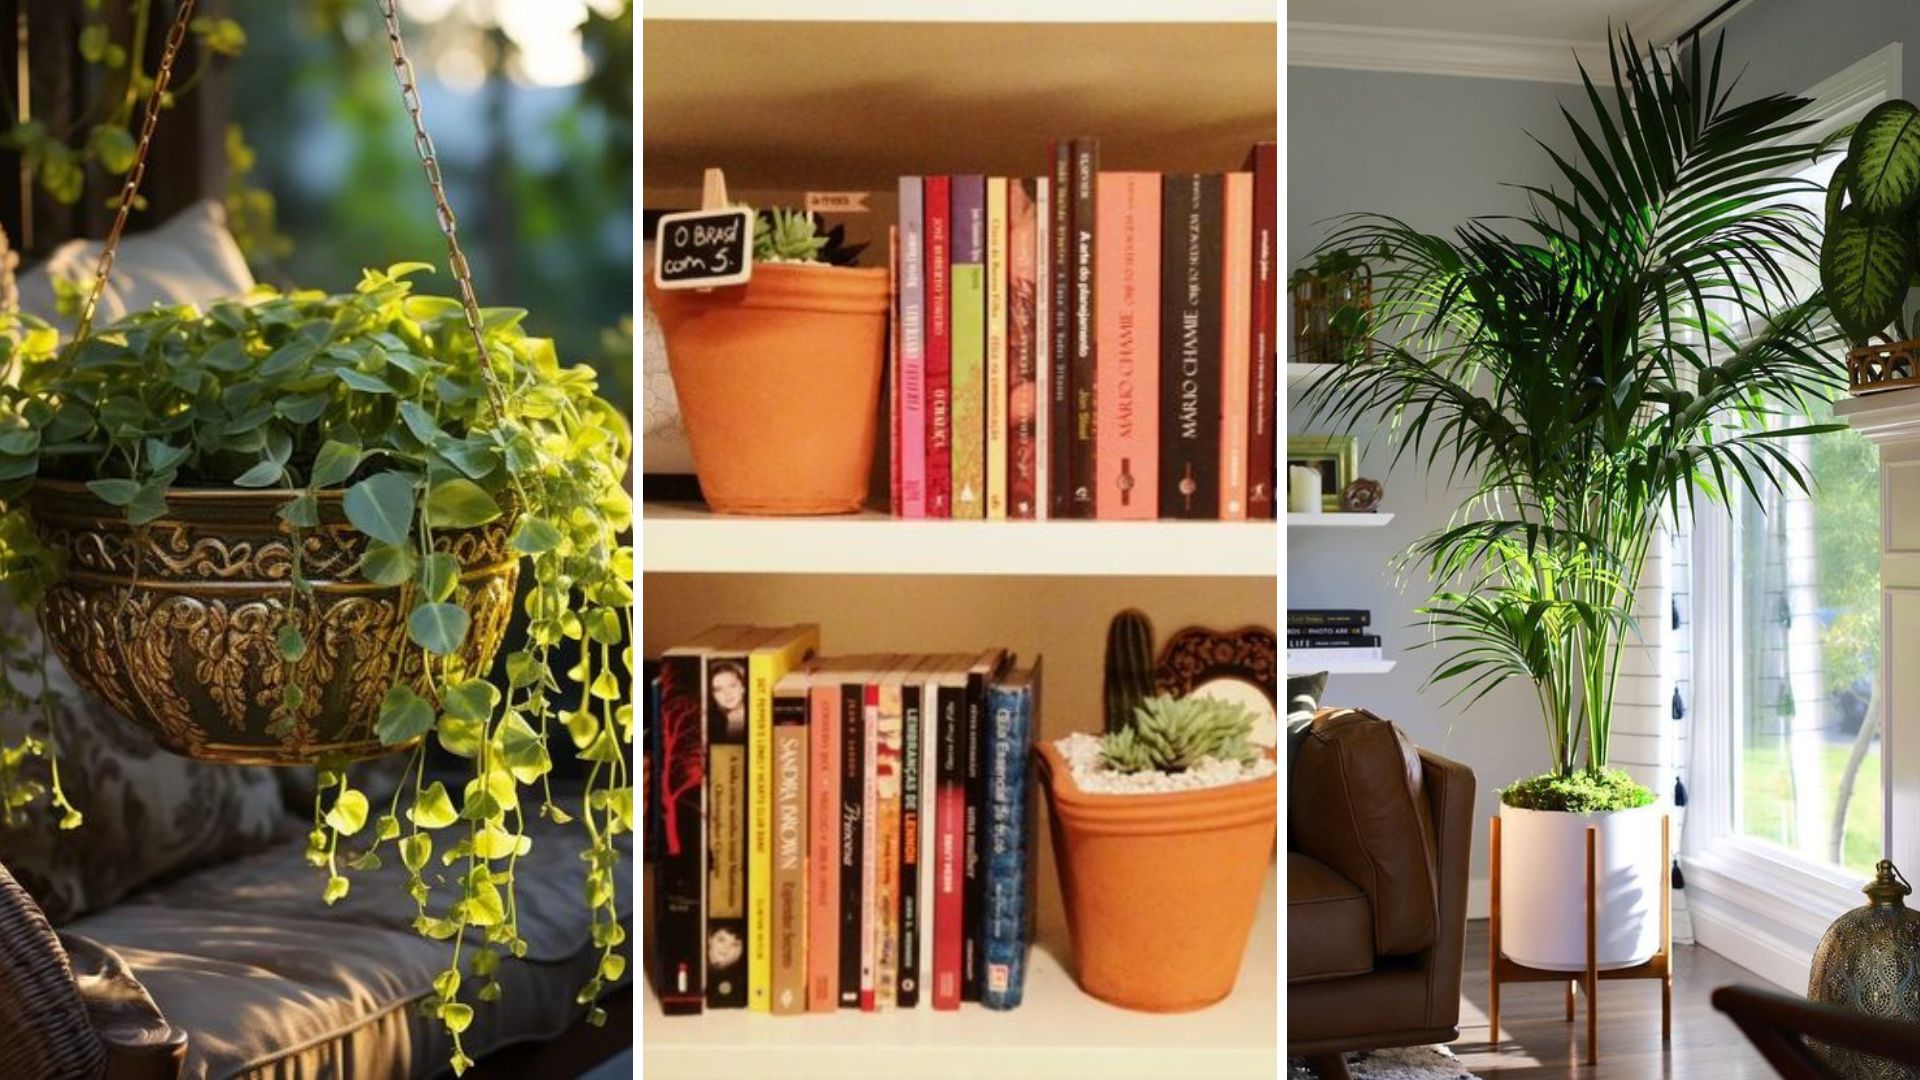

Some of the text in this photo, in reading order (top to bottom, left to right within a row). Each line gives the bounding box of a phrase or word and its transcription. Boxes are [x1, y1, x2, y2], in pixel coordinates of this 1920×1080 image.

[664, 255, 706, 275] com
[674, 226, 689, 248] O
[1077, 230, 1092, 358] A arte do planejamento
[1118, 310, 1134, 376] CHAMIE
[1182, 310, 1199, 377] CHAMIE
[1118, 380, 1133, 438] MÁRIO
[1181, 380, 1198, 438] MÁRIO
[781, 737, 799, 802] SANDRA
[904, 708, 918, 865] LEMBRANÇAS DE LENNON
[782, 805, 799, 870] BROWN
[967, 806, 976, 833] uma
